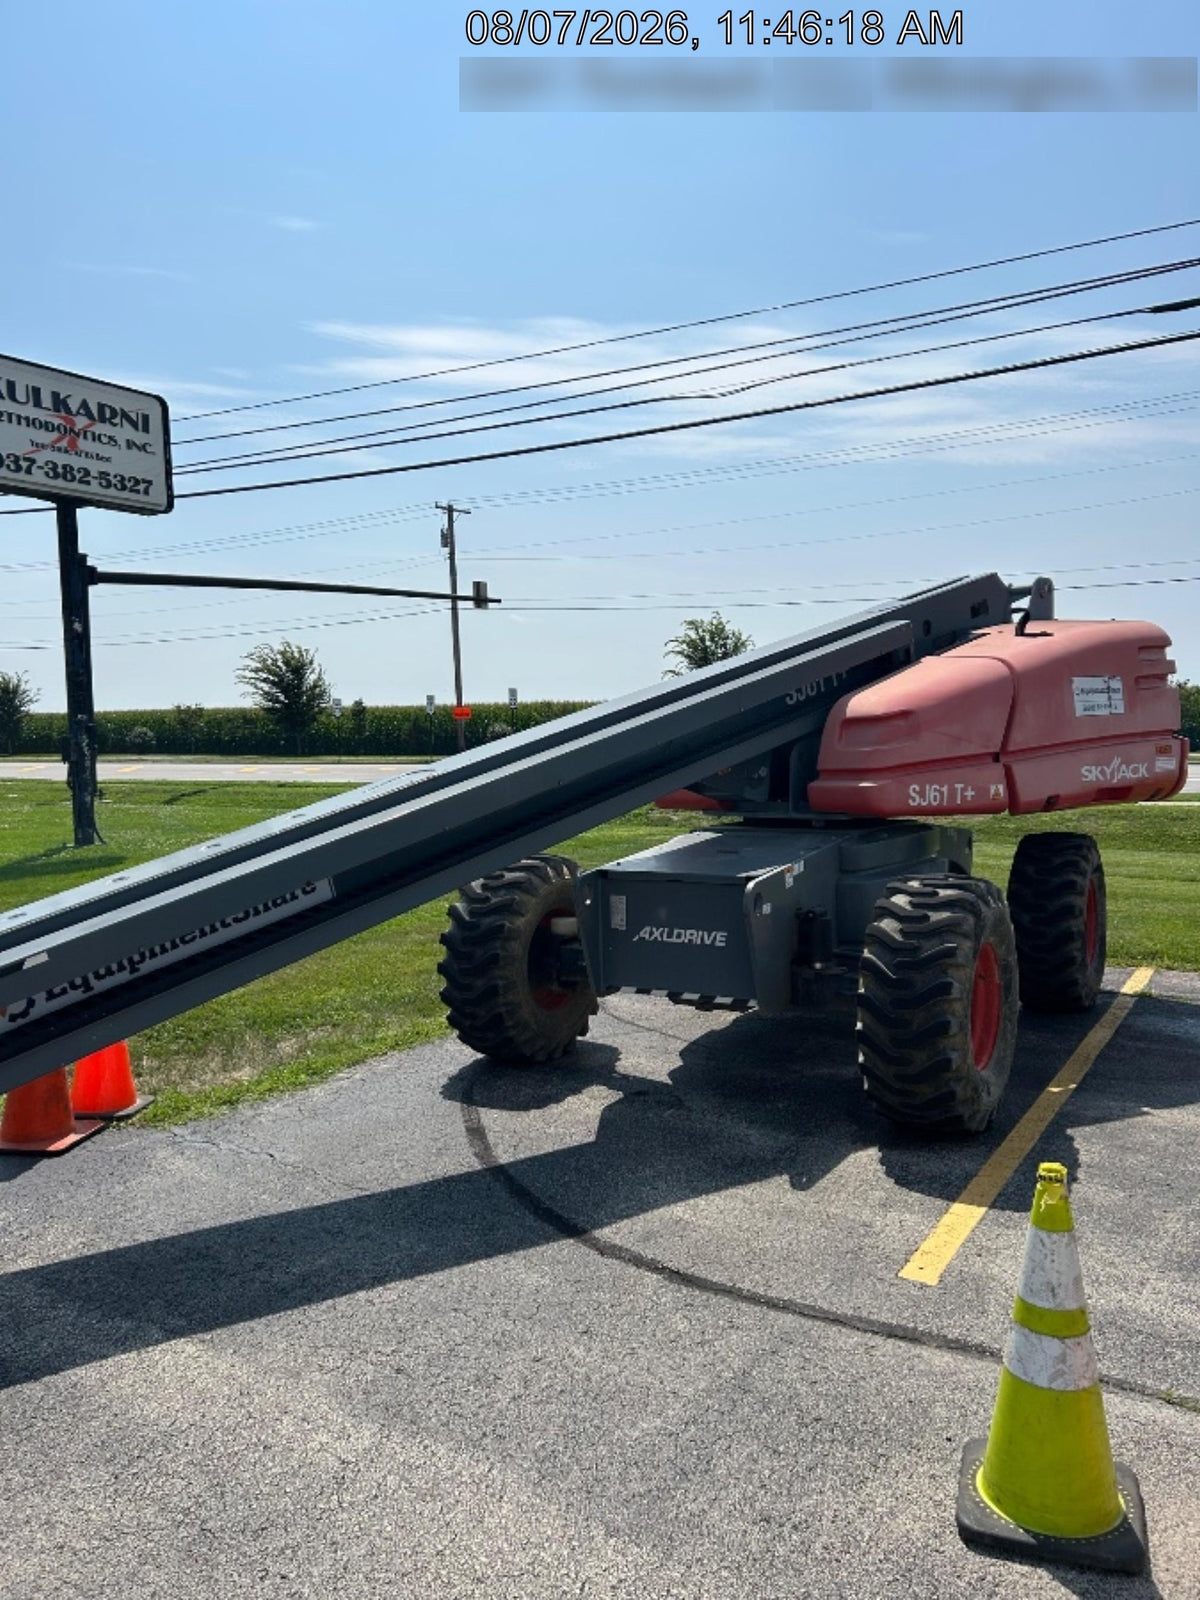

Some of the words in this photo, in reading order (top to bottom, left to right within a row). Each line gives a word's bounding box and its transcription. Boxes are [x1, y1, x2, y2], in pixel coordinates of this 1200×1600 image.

[1080, 755, 1150, 783] SKYJACK
[908, 784, 948, 806] SJ61
[954, 783, 975, 804] T+
[633, 925, 728, 947] AXLDRIVE
